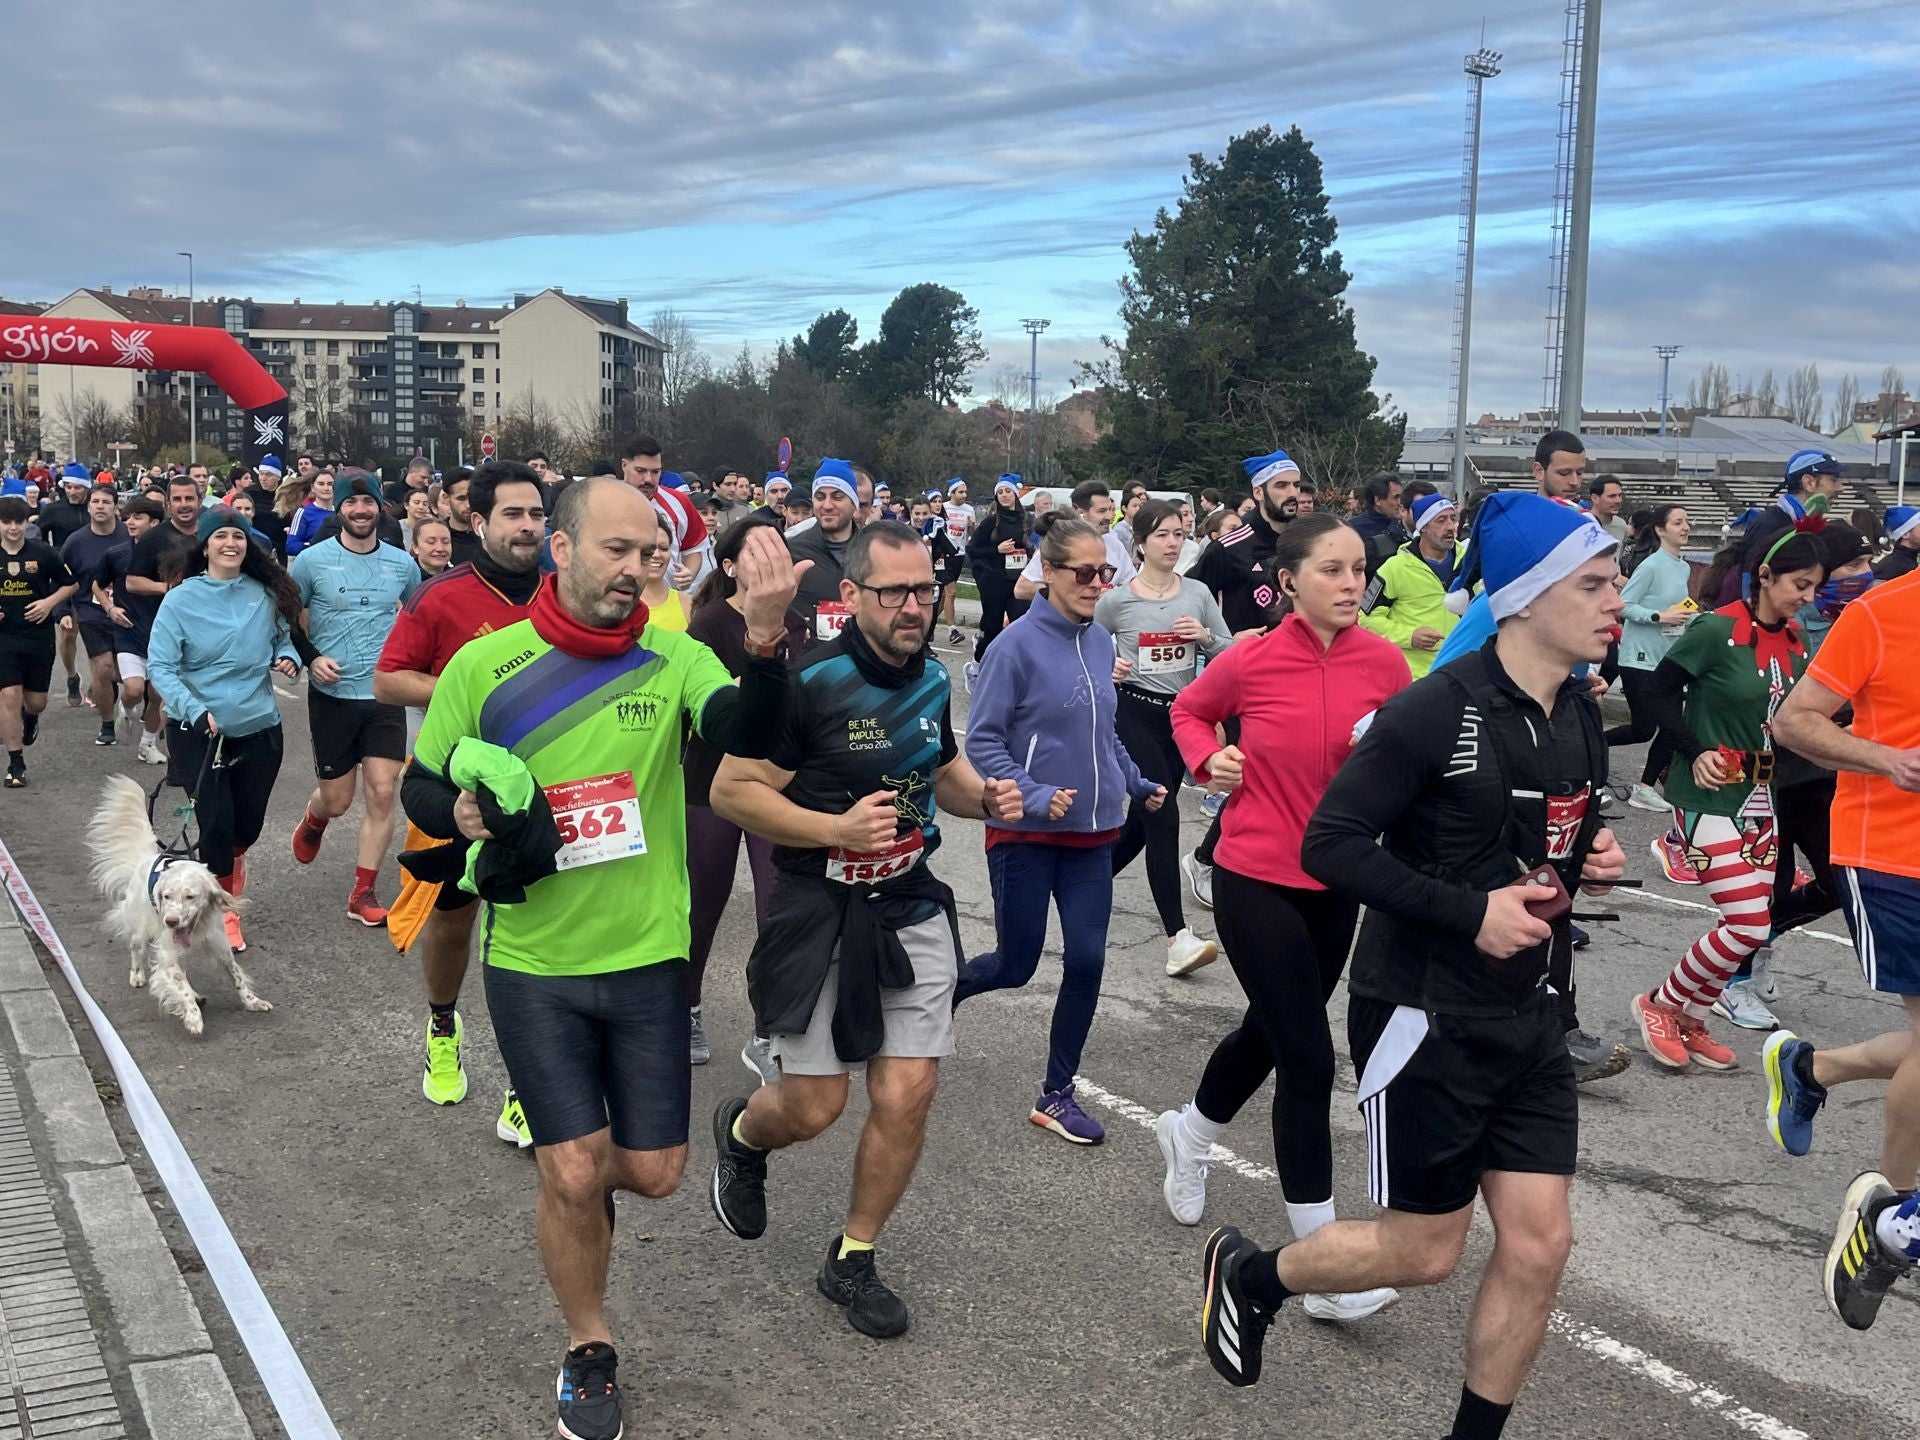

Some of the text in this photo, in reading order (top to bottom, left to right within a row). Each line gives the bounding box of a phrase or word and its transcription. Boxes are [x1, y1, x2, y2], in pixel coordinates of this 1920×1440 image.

[3, 324, 99, 360] gijón
[3, 579, 28, 590] Qatar
[1151, 646, 1185, 662] 550
[492, 649, 536, 680] Joma
[848, 718, 878, 730] BE THE
[848, 729, 886, 741] IMPULSE
[848, 742, 874, 751] Curso
[572, 792, 582, 800] de
[551, 797, 605, 813] Nochebuena
[555, 805, 626, 845] 562
